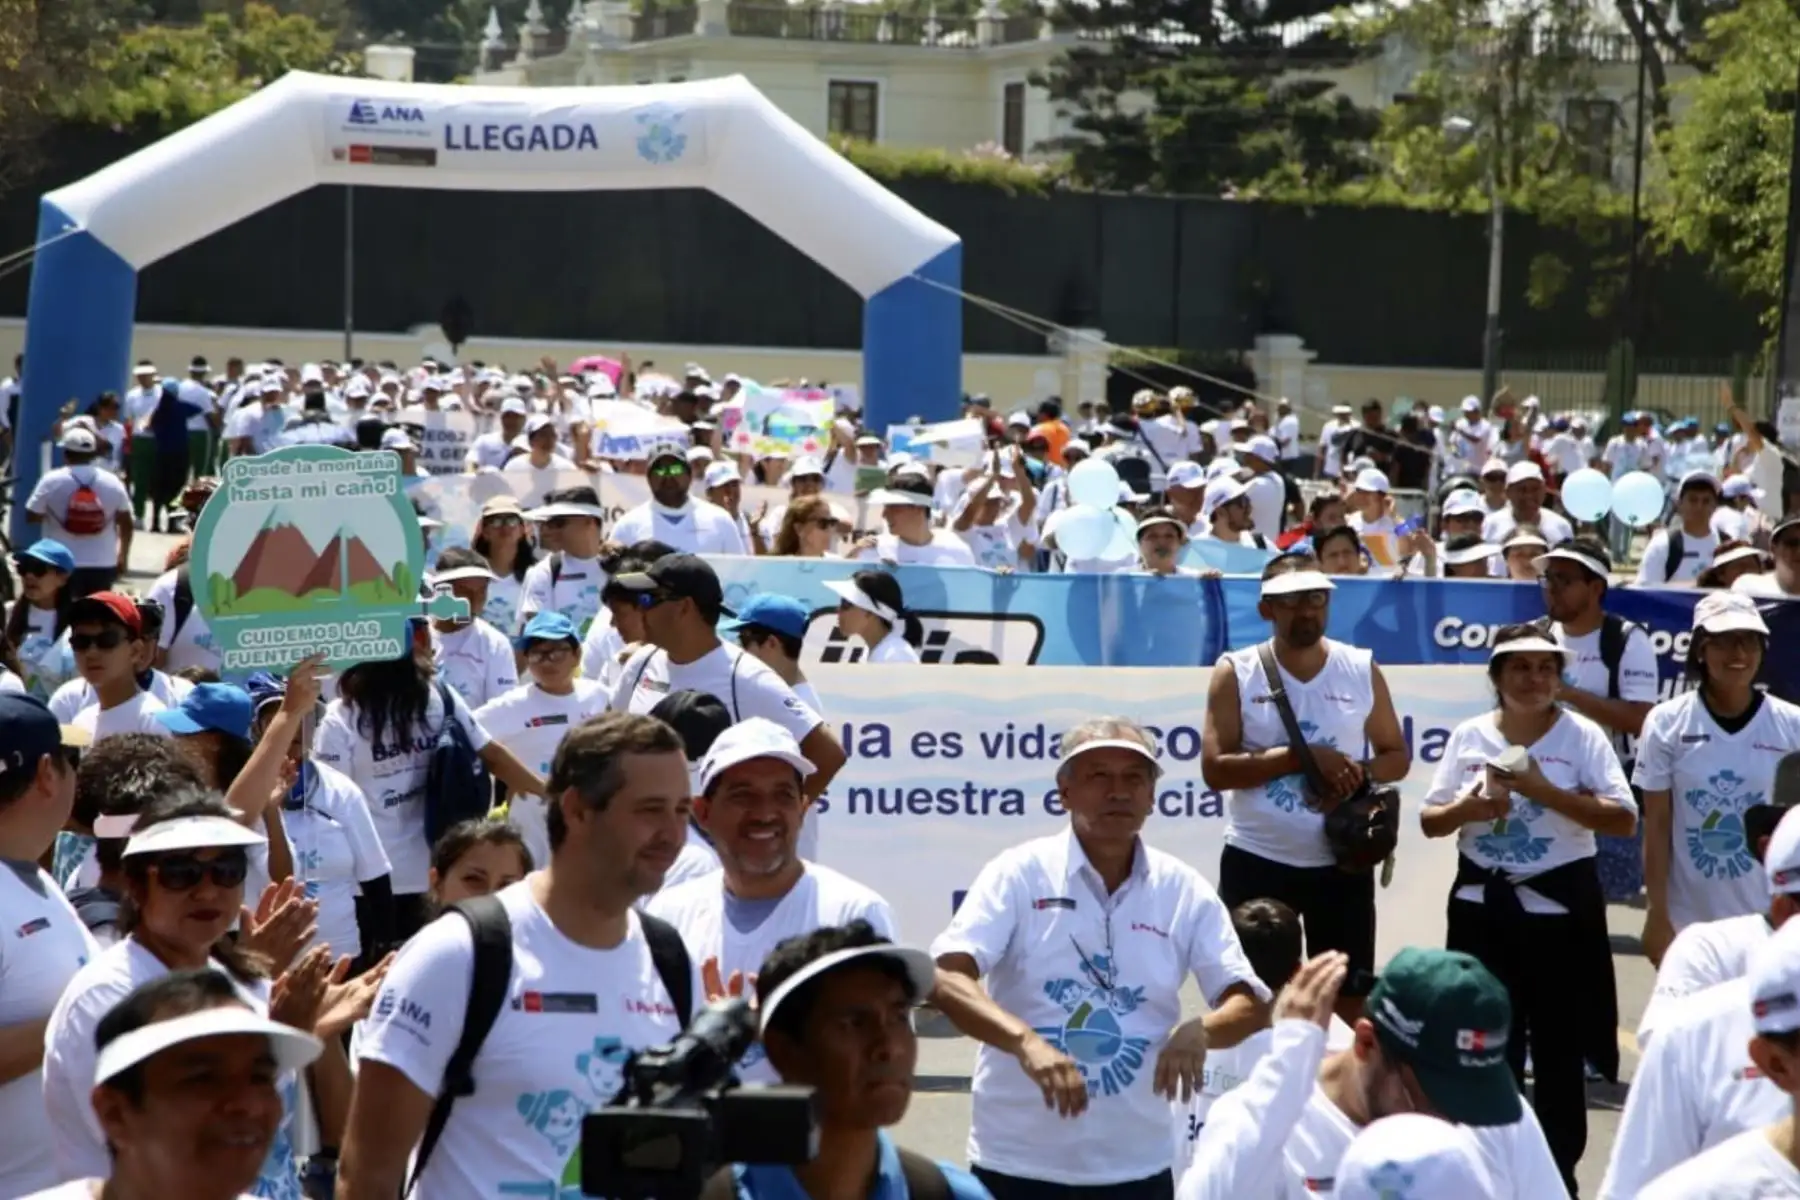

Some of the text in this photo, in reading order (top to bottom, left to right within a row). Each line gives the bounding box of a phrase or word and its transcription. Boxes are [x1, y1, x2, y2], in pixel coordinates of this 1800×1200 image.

[382, 106, 424, 121] ANA
[444, 122, 599, 151] LLEGADA
[230, 456, 395, 480] ¡Desde la montaña
[231, 475, 395, 502] hasta mi caño!
[240, 622, 380, 645] CUIDEMOS LAS
[318, 643, 345, 659] DE
[349, 640, 399, 658] AGUA
[911, 729, 963, 759] es
[848, 781, 1025, 816] nuestra
[1101, 1036, 1151, 1096] AGUA
